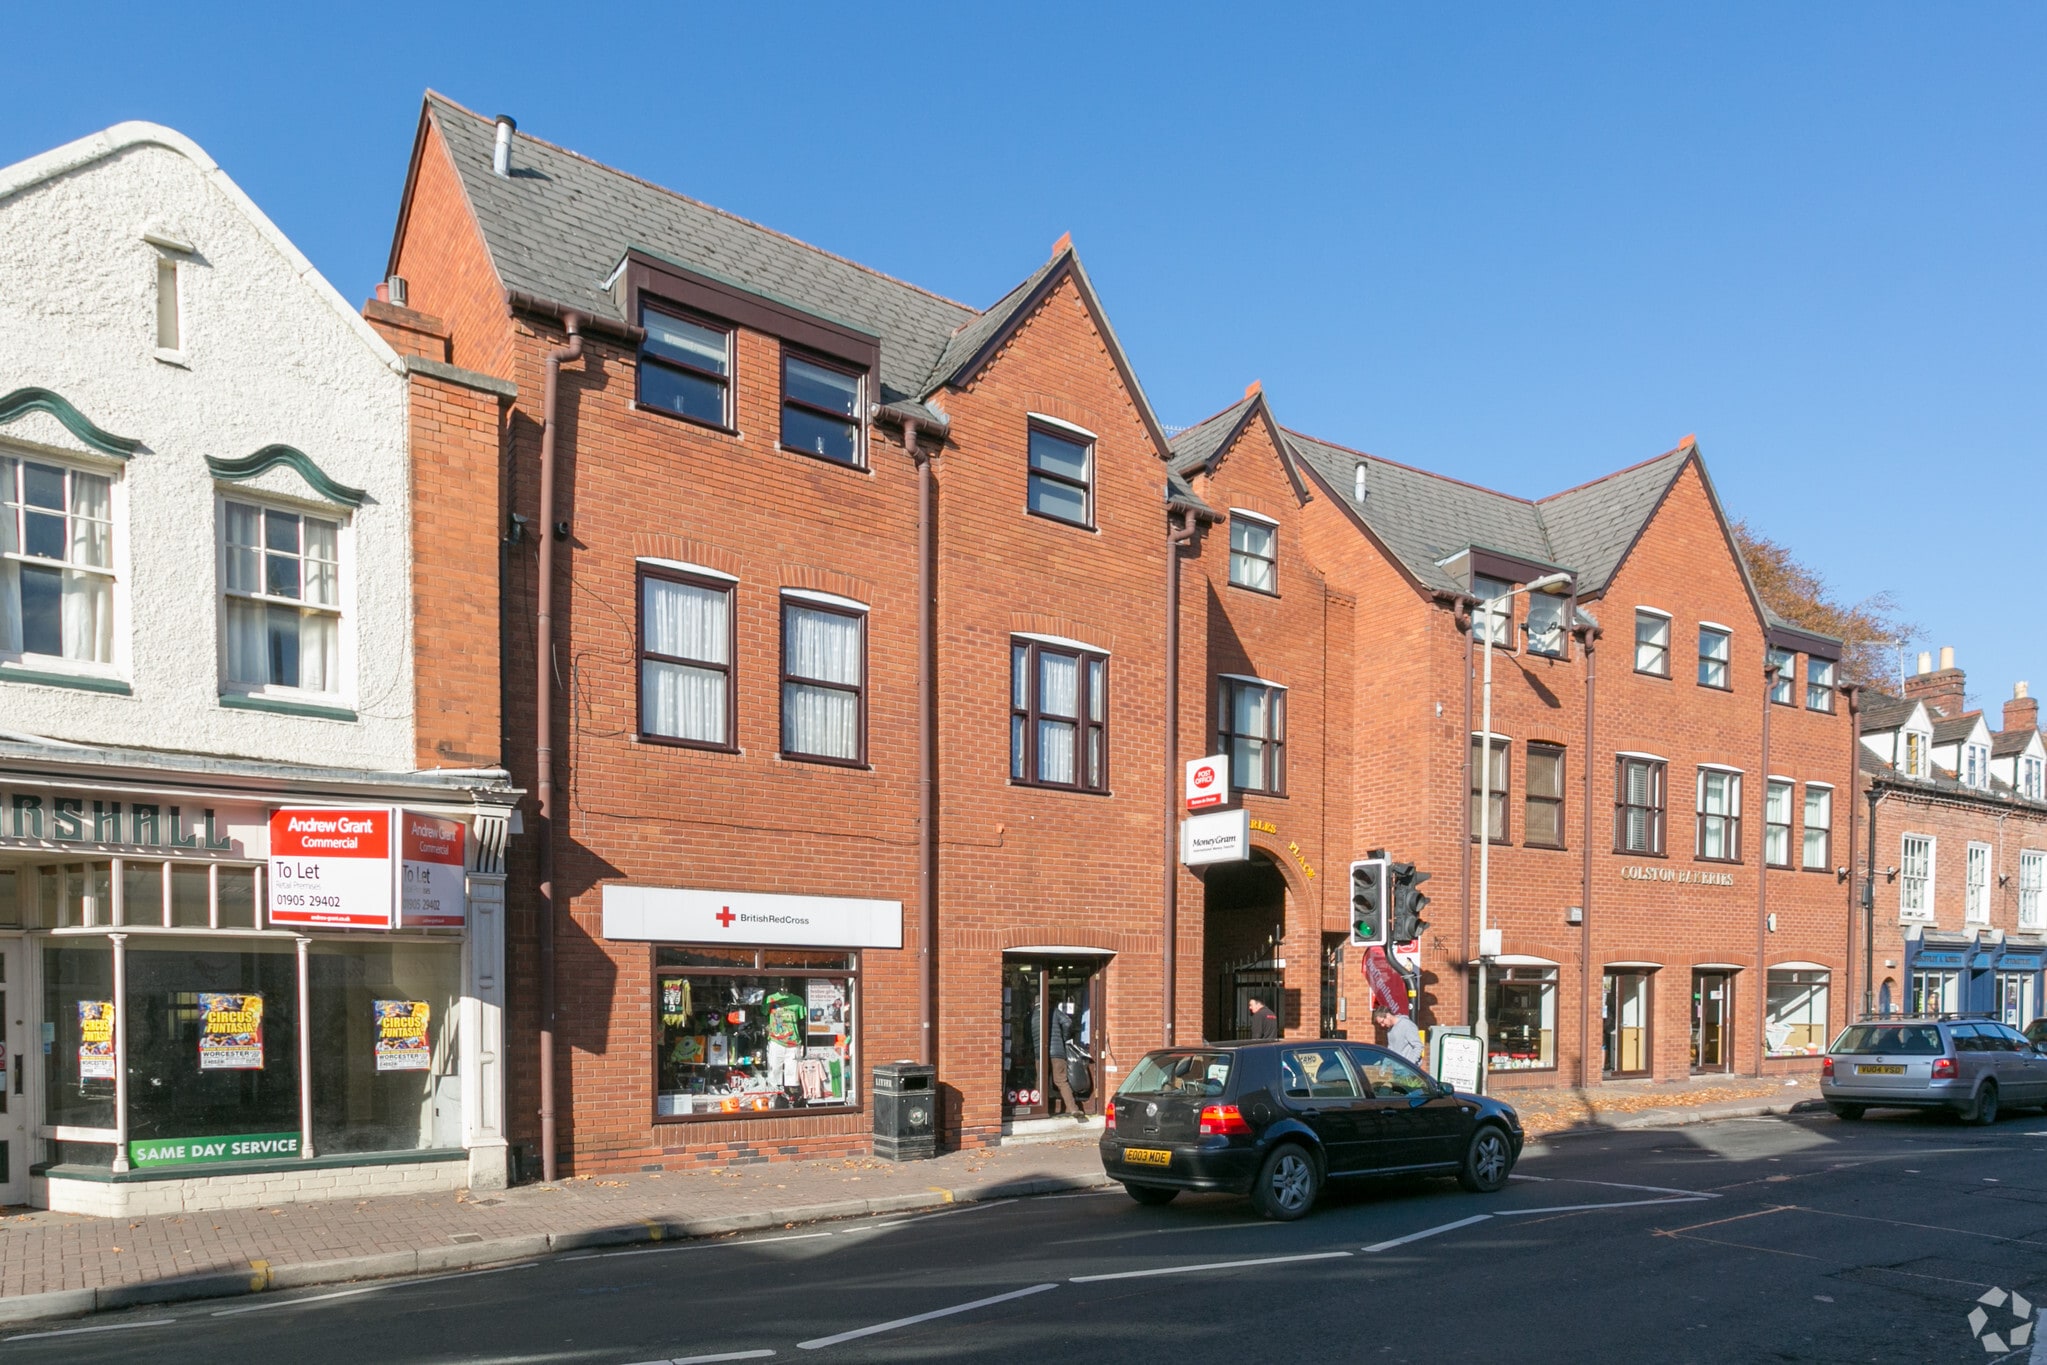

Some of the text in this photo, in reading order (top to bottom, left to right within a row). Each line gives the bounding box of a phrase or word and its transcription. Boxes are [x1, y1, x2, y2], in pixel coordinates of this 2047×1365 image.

[1195, 775, 1213, 784] OFFICE
[1198, 770, 1211, 778] POST
[0, 794, 232, 850] RSHALL
[287, 816, 373, 834] Andrew Grant
[411, 821, 457, 842] Andrew Grant
[301, 836, 358, 850] Commercial
[419, 840, 449, 856] Commercial
[1192, 835, 1237, 848] MoneyGram
[276, 861, 320, 880] To Let
[402, 865, 431, 884] To Let
[1621, 865, 1734, 886] COLSTON BAKERIES
[276, 894, 341, 908] 01905 29402
[740, 913, 810, 925] BritishRedCross
[207, 1011, 253, 1023] CIRCUS
[382, 1016, 421, 1028] CIRCUS
[206, 1022, 254, 1034] FUNTASIA
[381, 1028, 423, 1038] FUNTASIA
[137, 1139, 298, 1161] SAME DAY SERVICE
[1148, 1151, 1168, 1164] MDE
